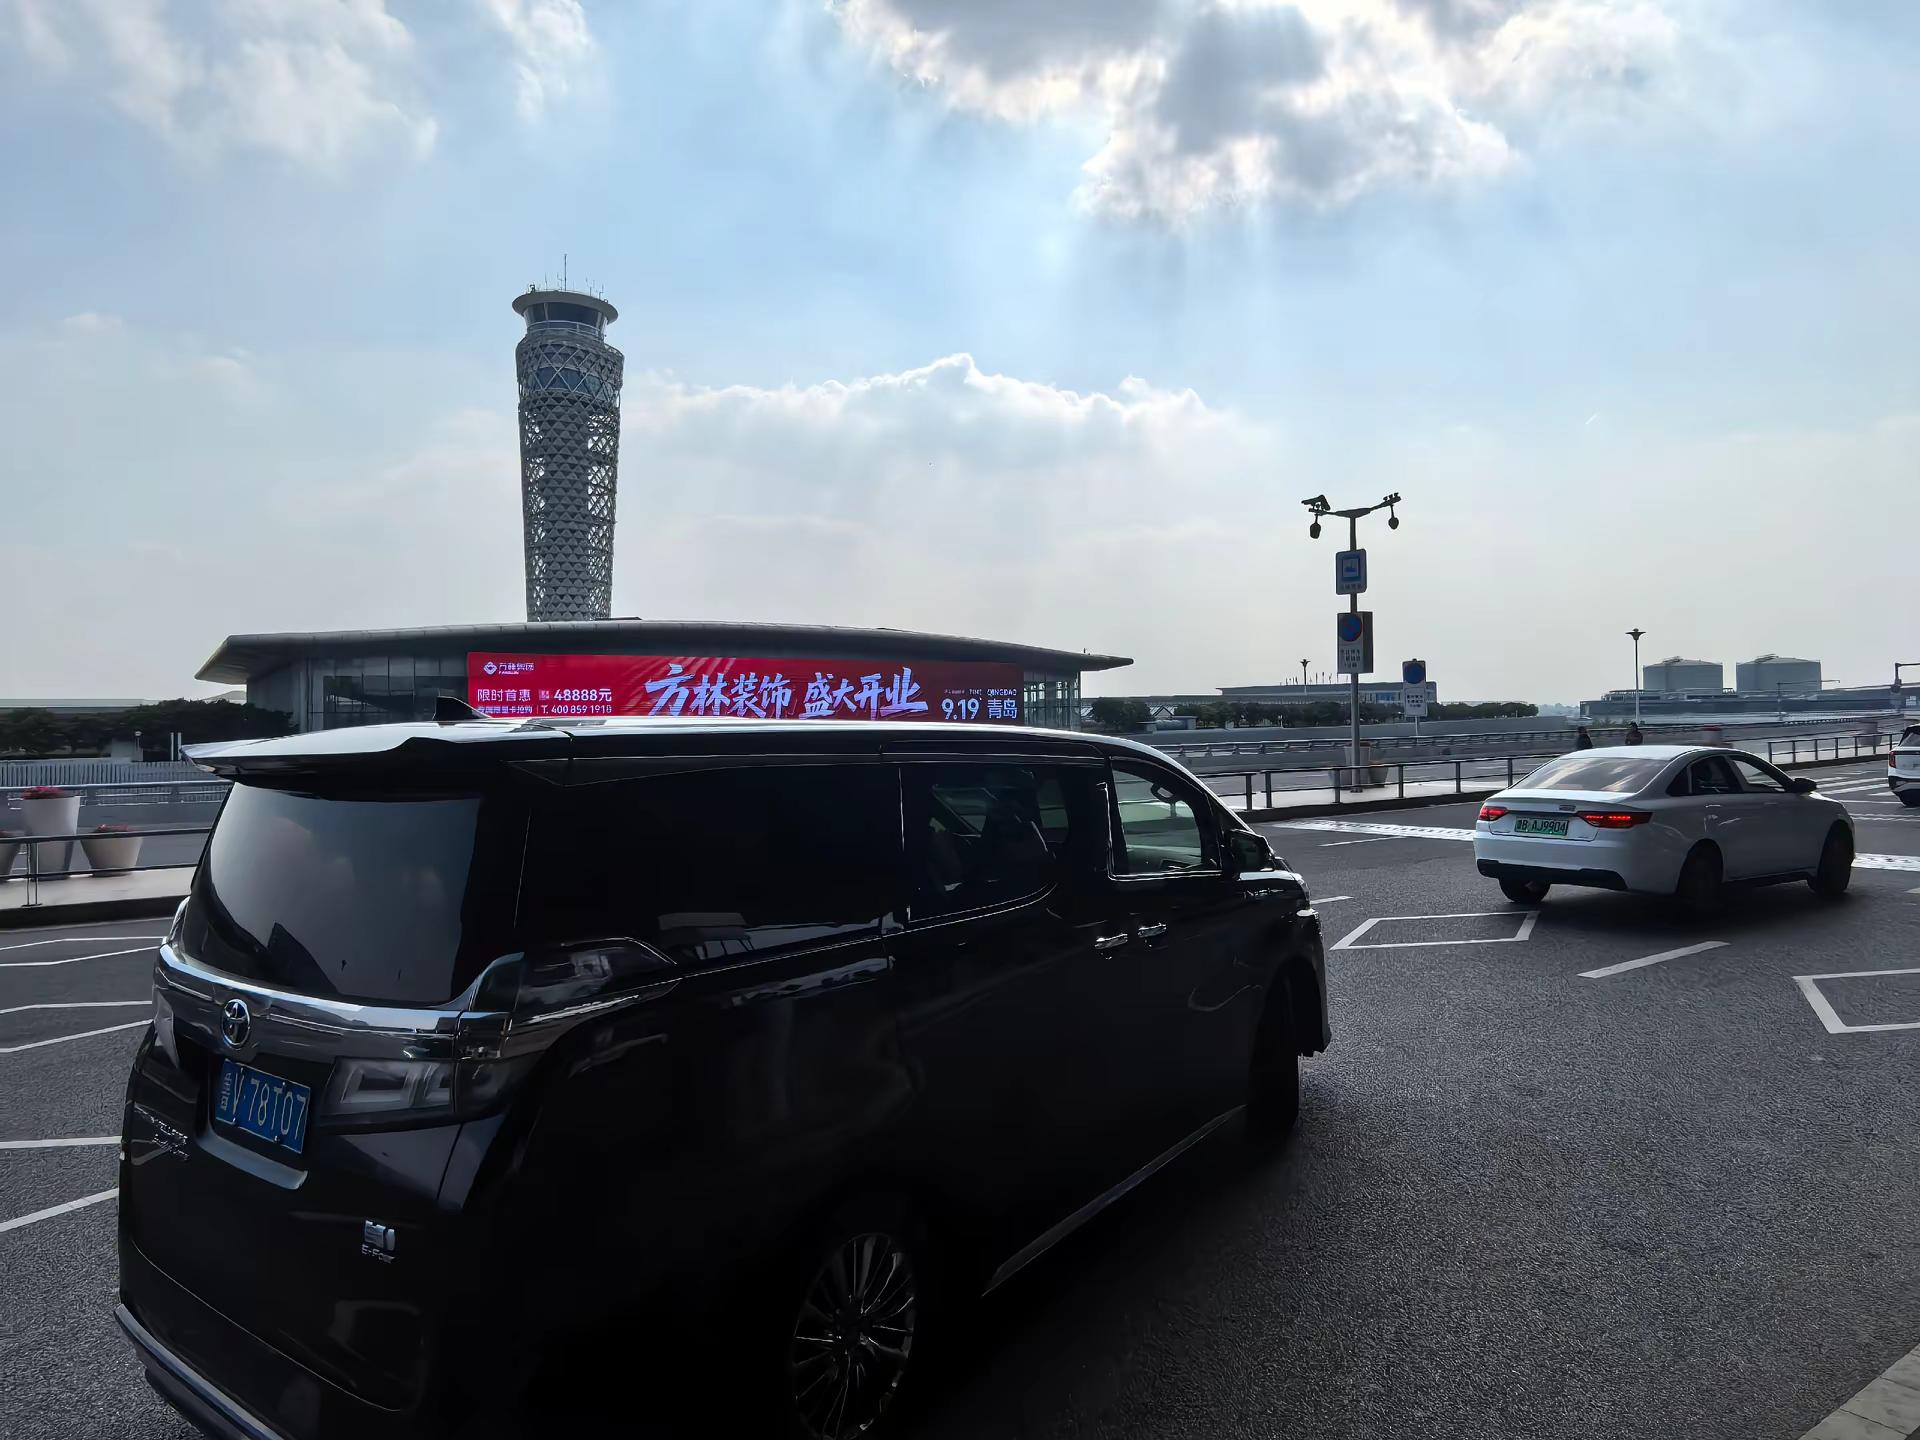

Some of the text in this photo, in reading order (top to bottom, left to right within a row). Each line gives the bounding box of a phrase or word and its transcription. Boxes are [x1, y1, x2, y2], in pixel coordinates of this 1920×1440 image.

[477, 689, 531, 702] 限时首惠
[645, 663, 929, 720] 方林装饰 盛大开业
[941, 698, 980, 720] 9.19
[987, 698, 1018, 719] 青岛
